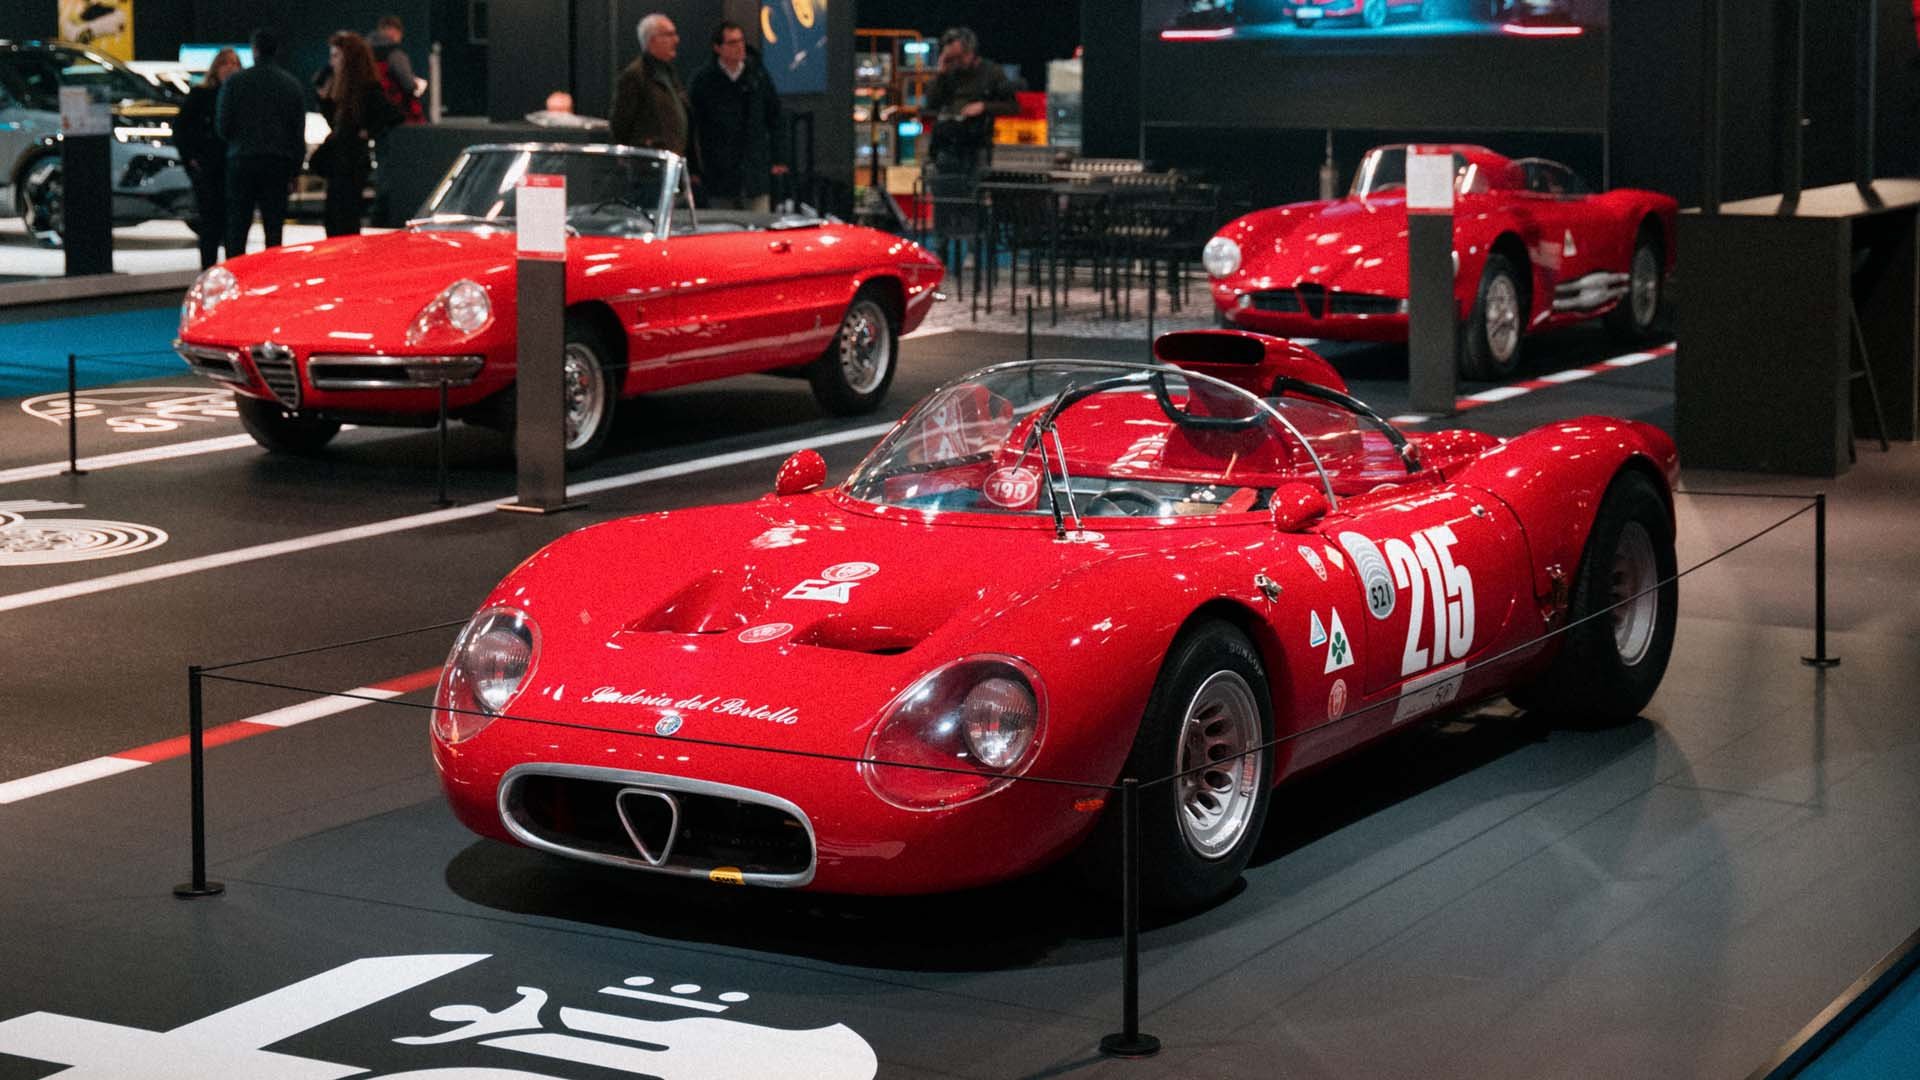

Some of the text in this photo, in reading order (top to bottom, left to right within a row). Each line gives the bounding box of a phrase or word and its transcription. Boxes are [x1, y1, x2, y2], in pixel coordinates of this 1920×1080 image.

[991, 481, 1029, 500] 198
[1370, 583, 1392, 610] 521
[1385, 525, 1475, 677] 215
[582, 686, 799, 726] Sderia del Portello
